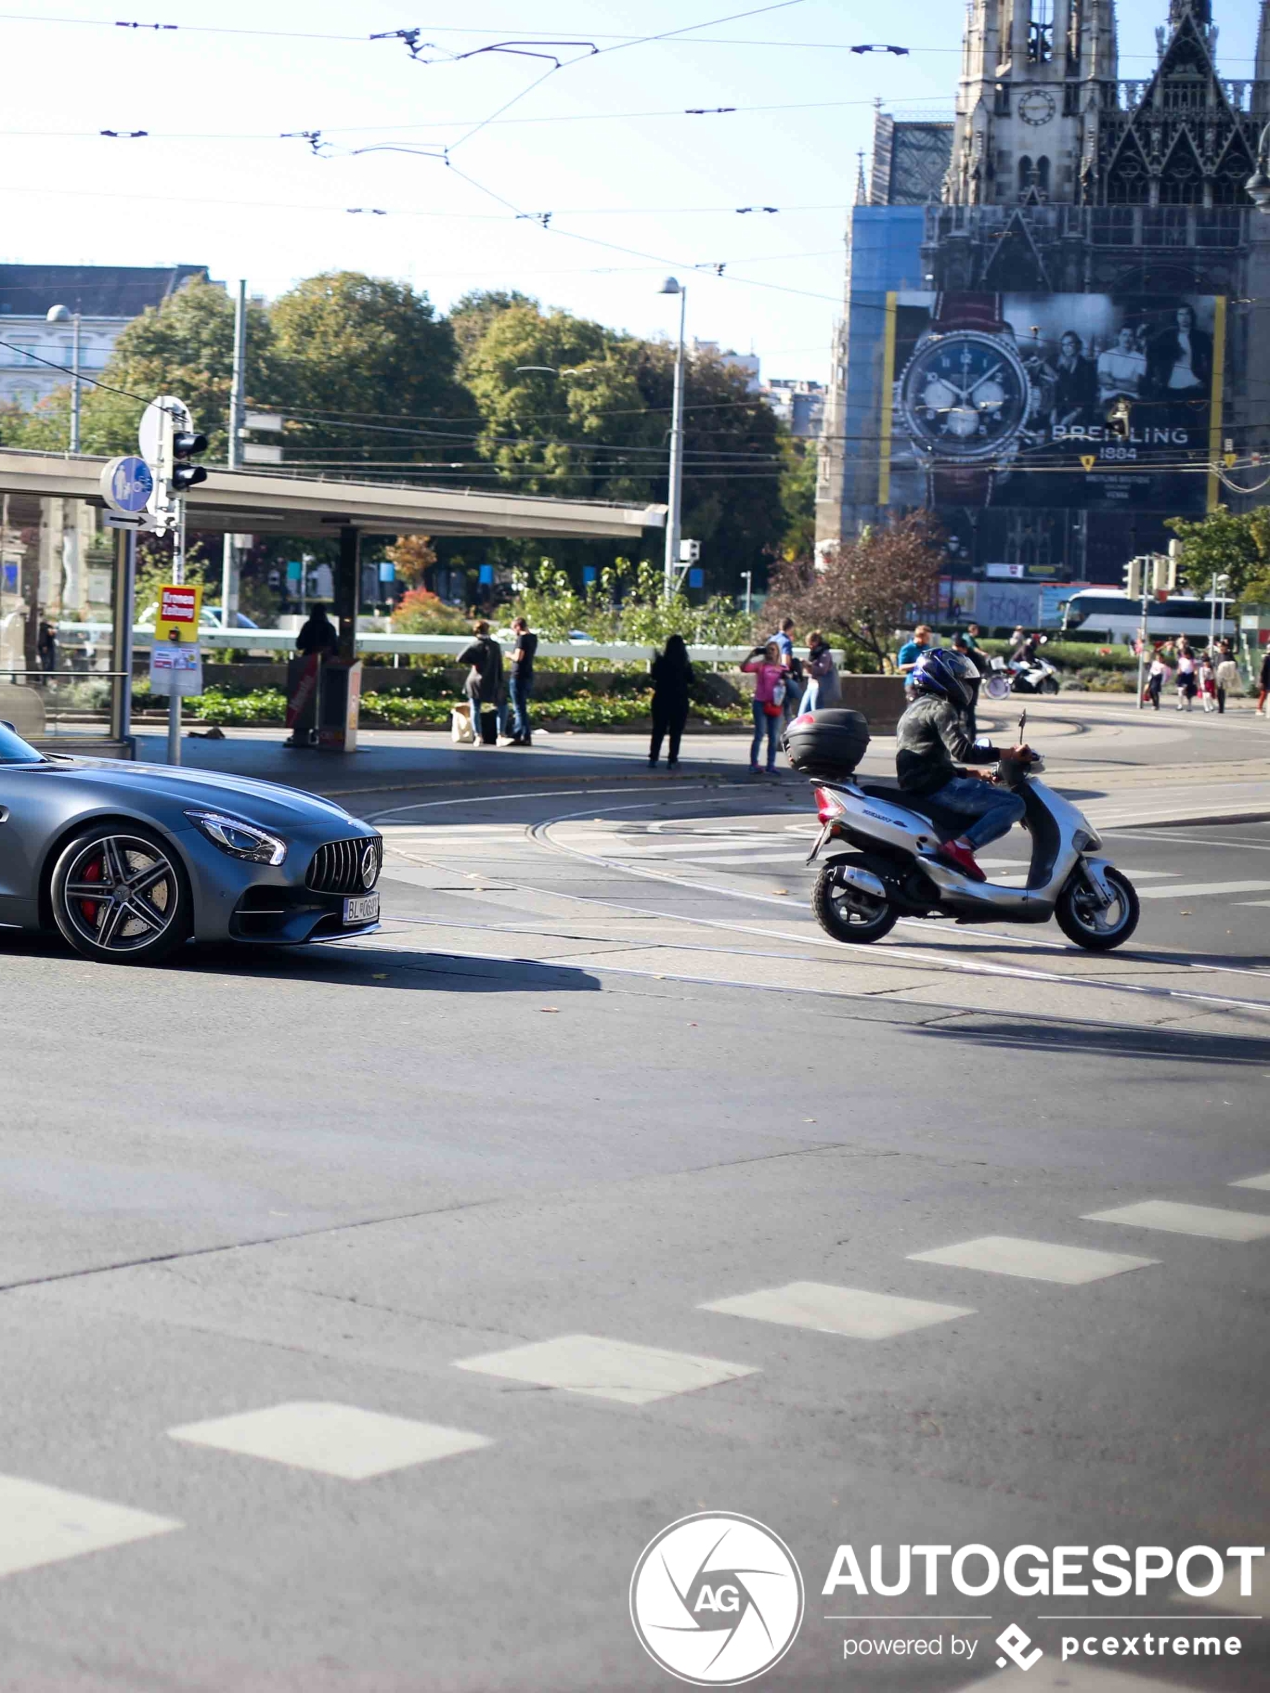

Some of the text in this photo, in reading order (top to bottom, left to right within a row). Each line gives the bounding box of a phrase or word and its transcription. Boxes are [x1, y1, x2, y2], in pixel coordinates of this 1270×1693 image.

[1100, 447, 1137, 459] 1884
[163, 592, 194, 604] Kronen
[162, 604, 194, 619] Zeitung
[349, 901, 359, 918] BL
